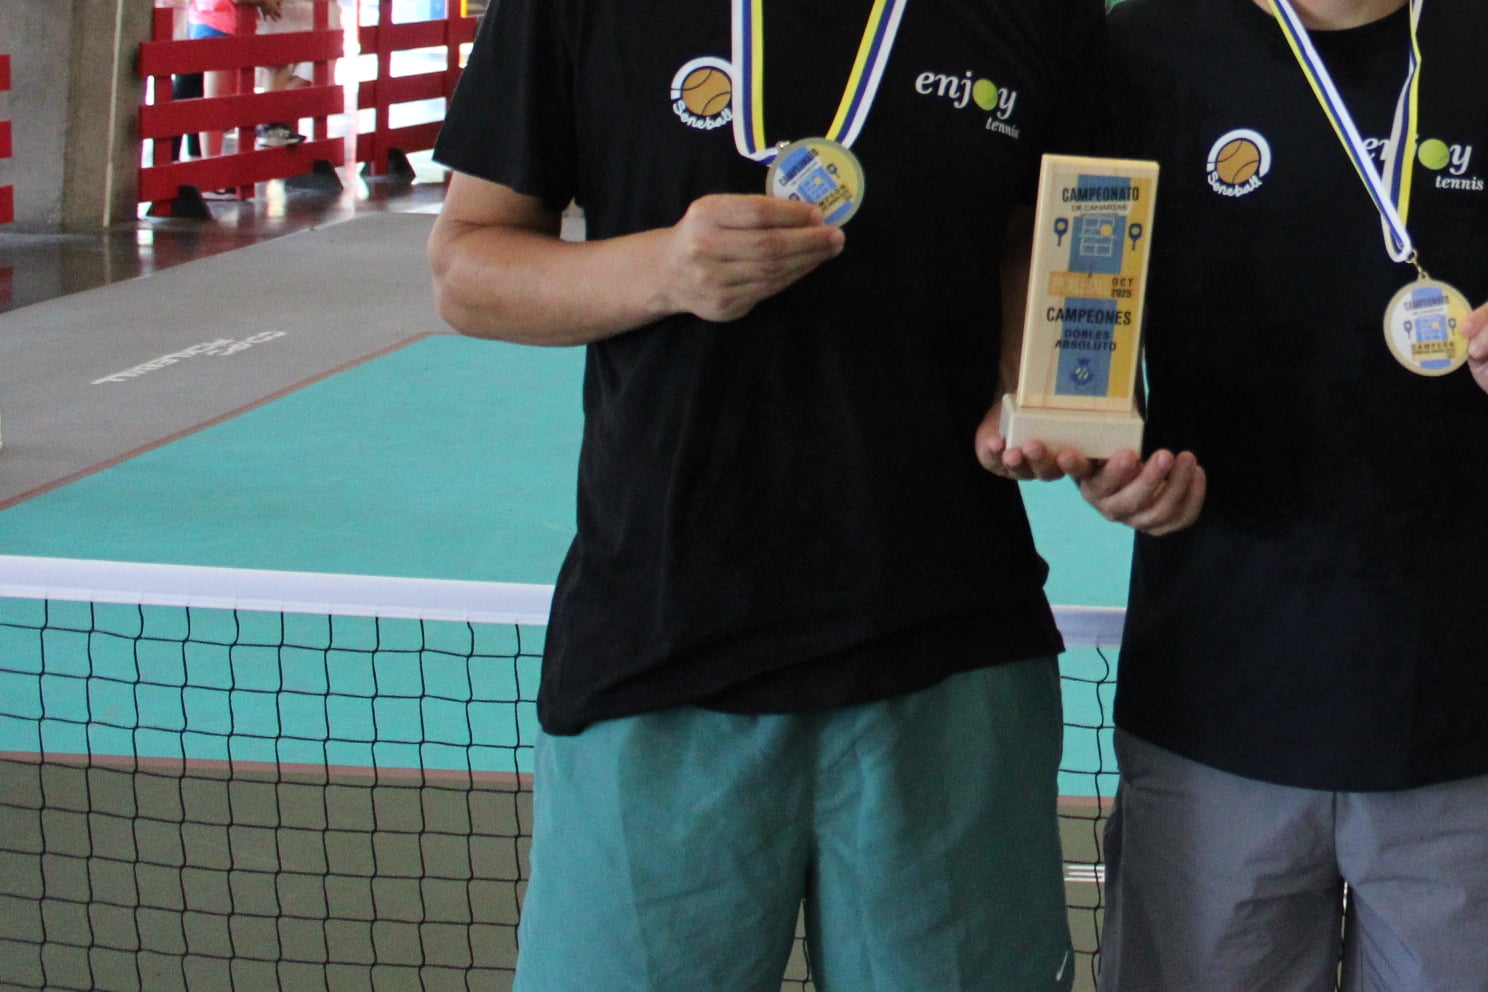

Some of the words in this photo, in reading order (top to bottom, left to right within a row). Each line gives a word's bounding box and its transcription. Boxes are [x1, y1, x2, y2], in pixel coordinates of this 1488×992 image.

[914, 70, 1018, 120] enjoy
[1435, 175, 1485, 191] tennis
[1062, 186, 1140, 203] CAMPEONATO
[1112, 277, 1135, 287] OCT
[1110, 289, 1132, 299] 2025
[1046, 307, 1132, 326] CAMPEONES
[1064, 329, 1110, 340] DOBLES
[1054, 340, 1117, 352] ABSOLUTO
